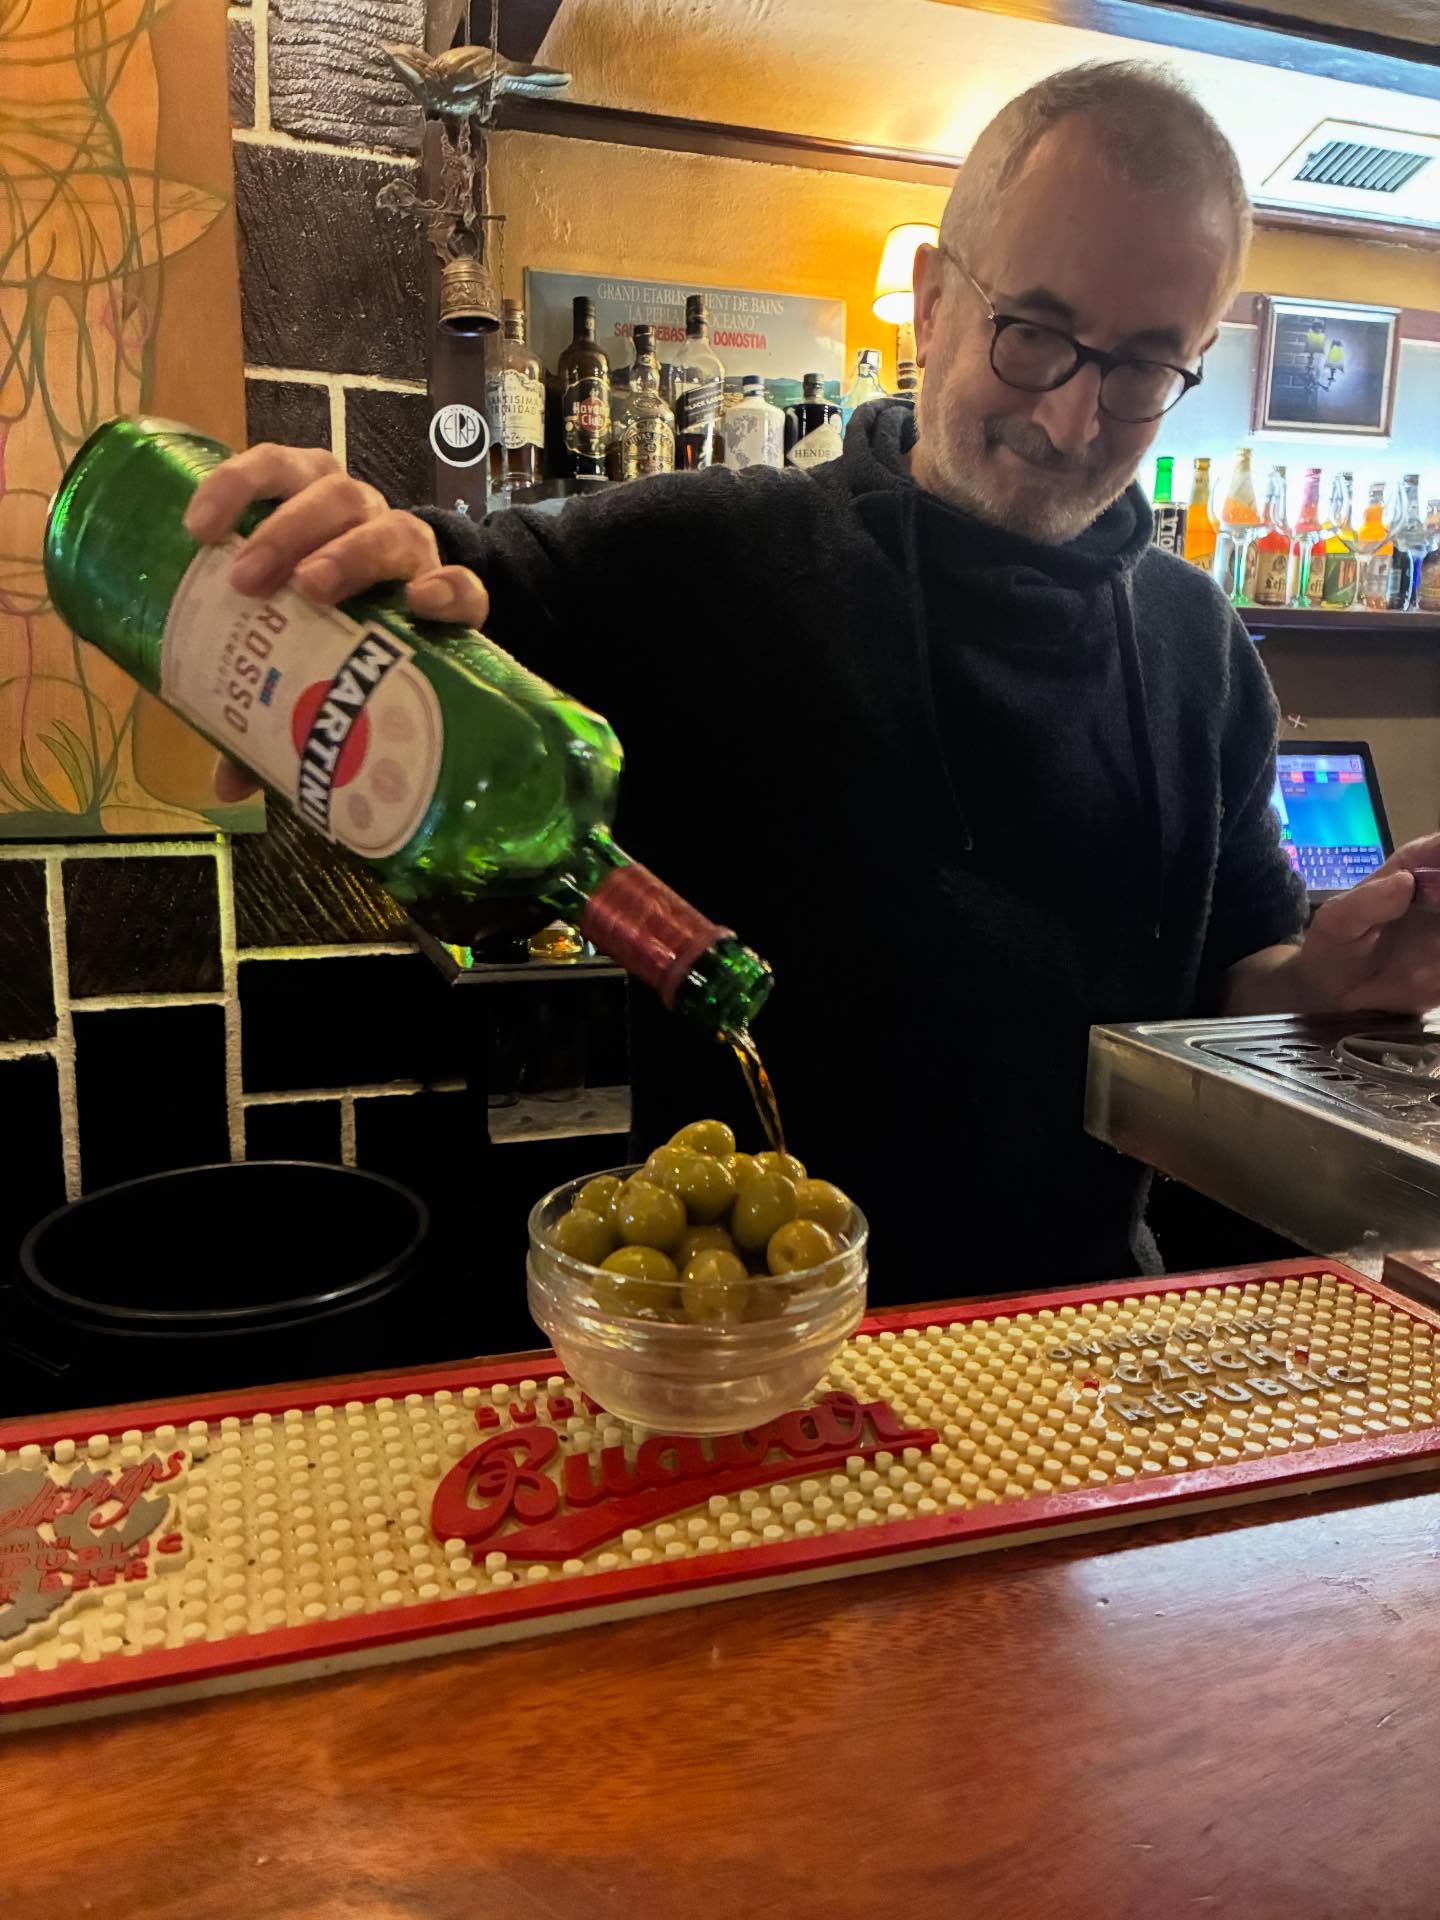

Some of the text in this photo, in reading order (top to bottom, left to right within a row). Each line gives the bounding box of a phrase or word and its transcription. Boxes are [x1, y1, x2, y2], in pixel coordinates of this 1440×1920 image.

[597, 282, 641, 303] GRAND
[733, 295, 750, 312] DE
[752, 297, 784, 315] BAINS
[713, 331, 767, 351] DONOSTIA
[223, 603, 288, 734] ROSSO
[299, 636, 398, 826] MARTINI
[1113, 1345, 1287, 1386] CZECH
[1107, 1365, 1367, 1421] REPUBLIC
